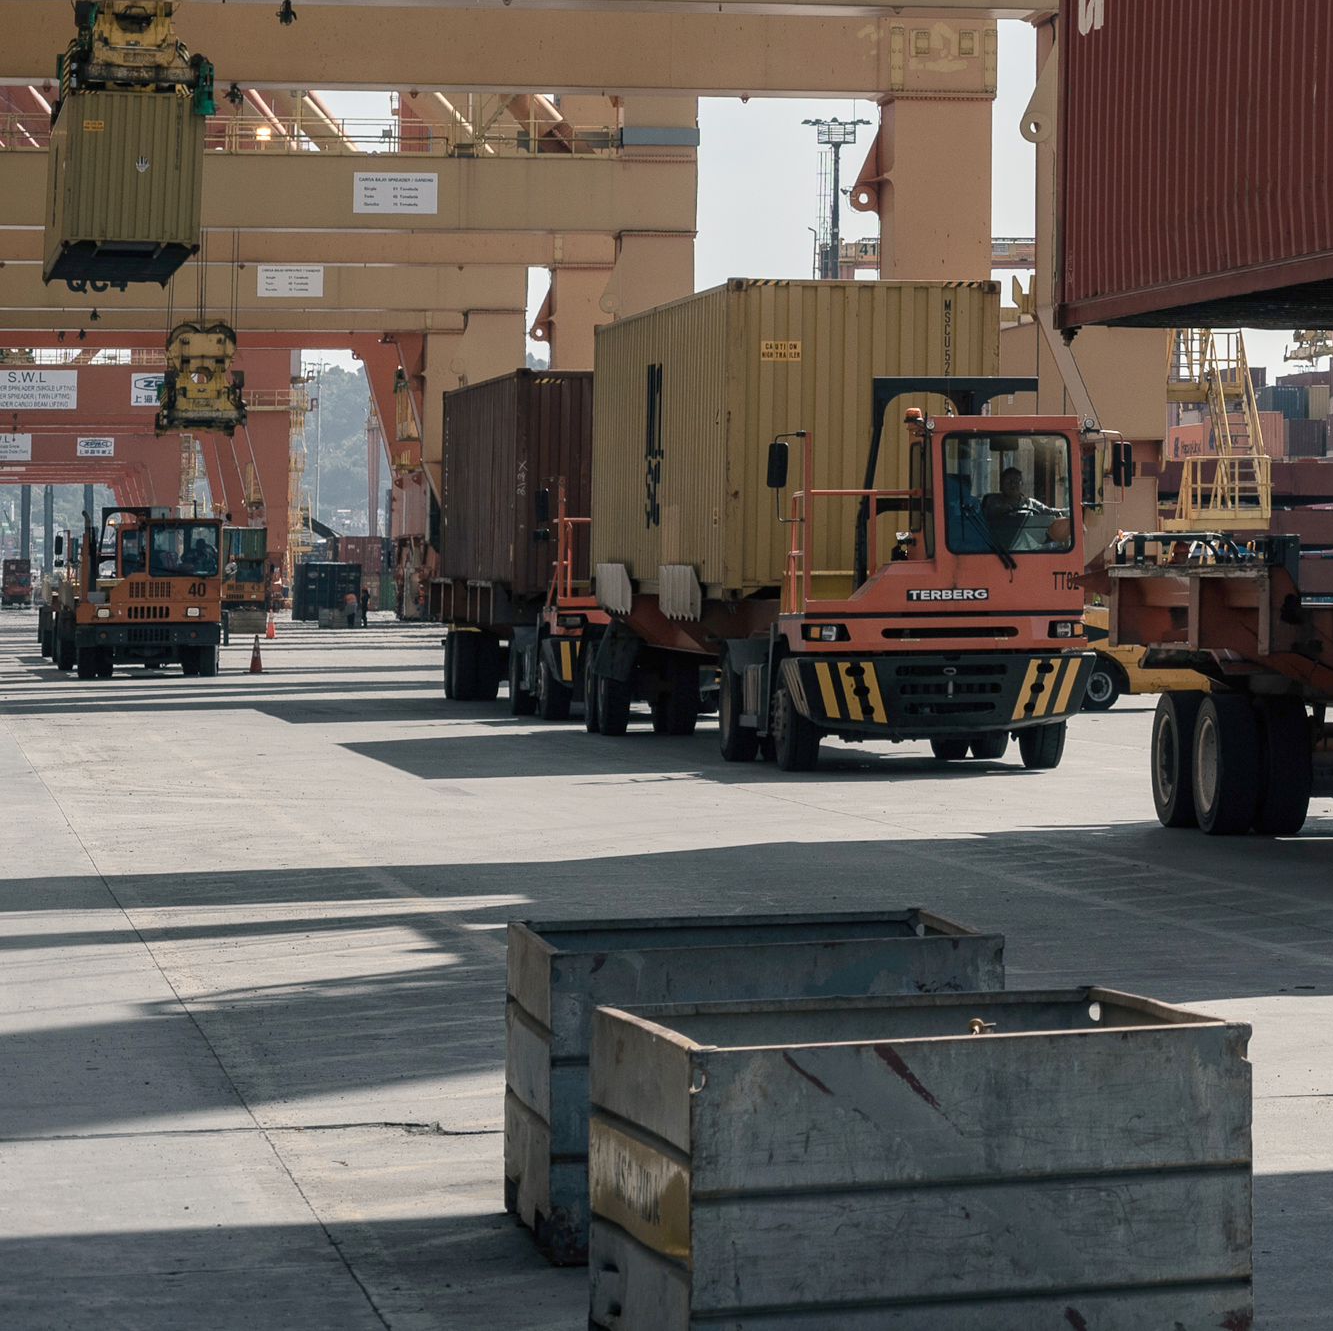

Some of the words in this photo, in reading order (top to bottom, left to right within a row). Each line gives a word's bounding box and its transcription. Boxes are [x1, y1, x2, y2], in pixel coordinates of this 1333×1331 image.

[860, 244, 876, 256] 41
[8, 372, 46, 382] S.W.L
[188, 583, 206, 598] 40
[909, 589, 988, 600] TERBERG
